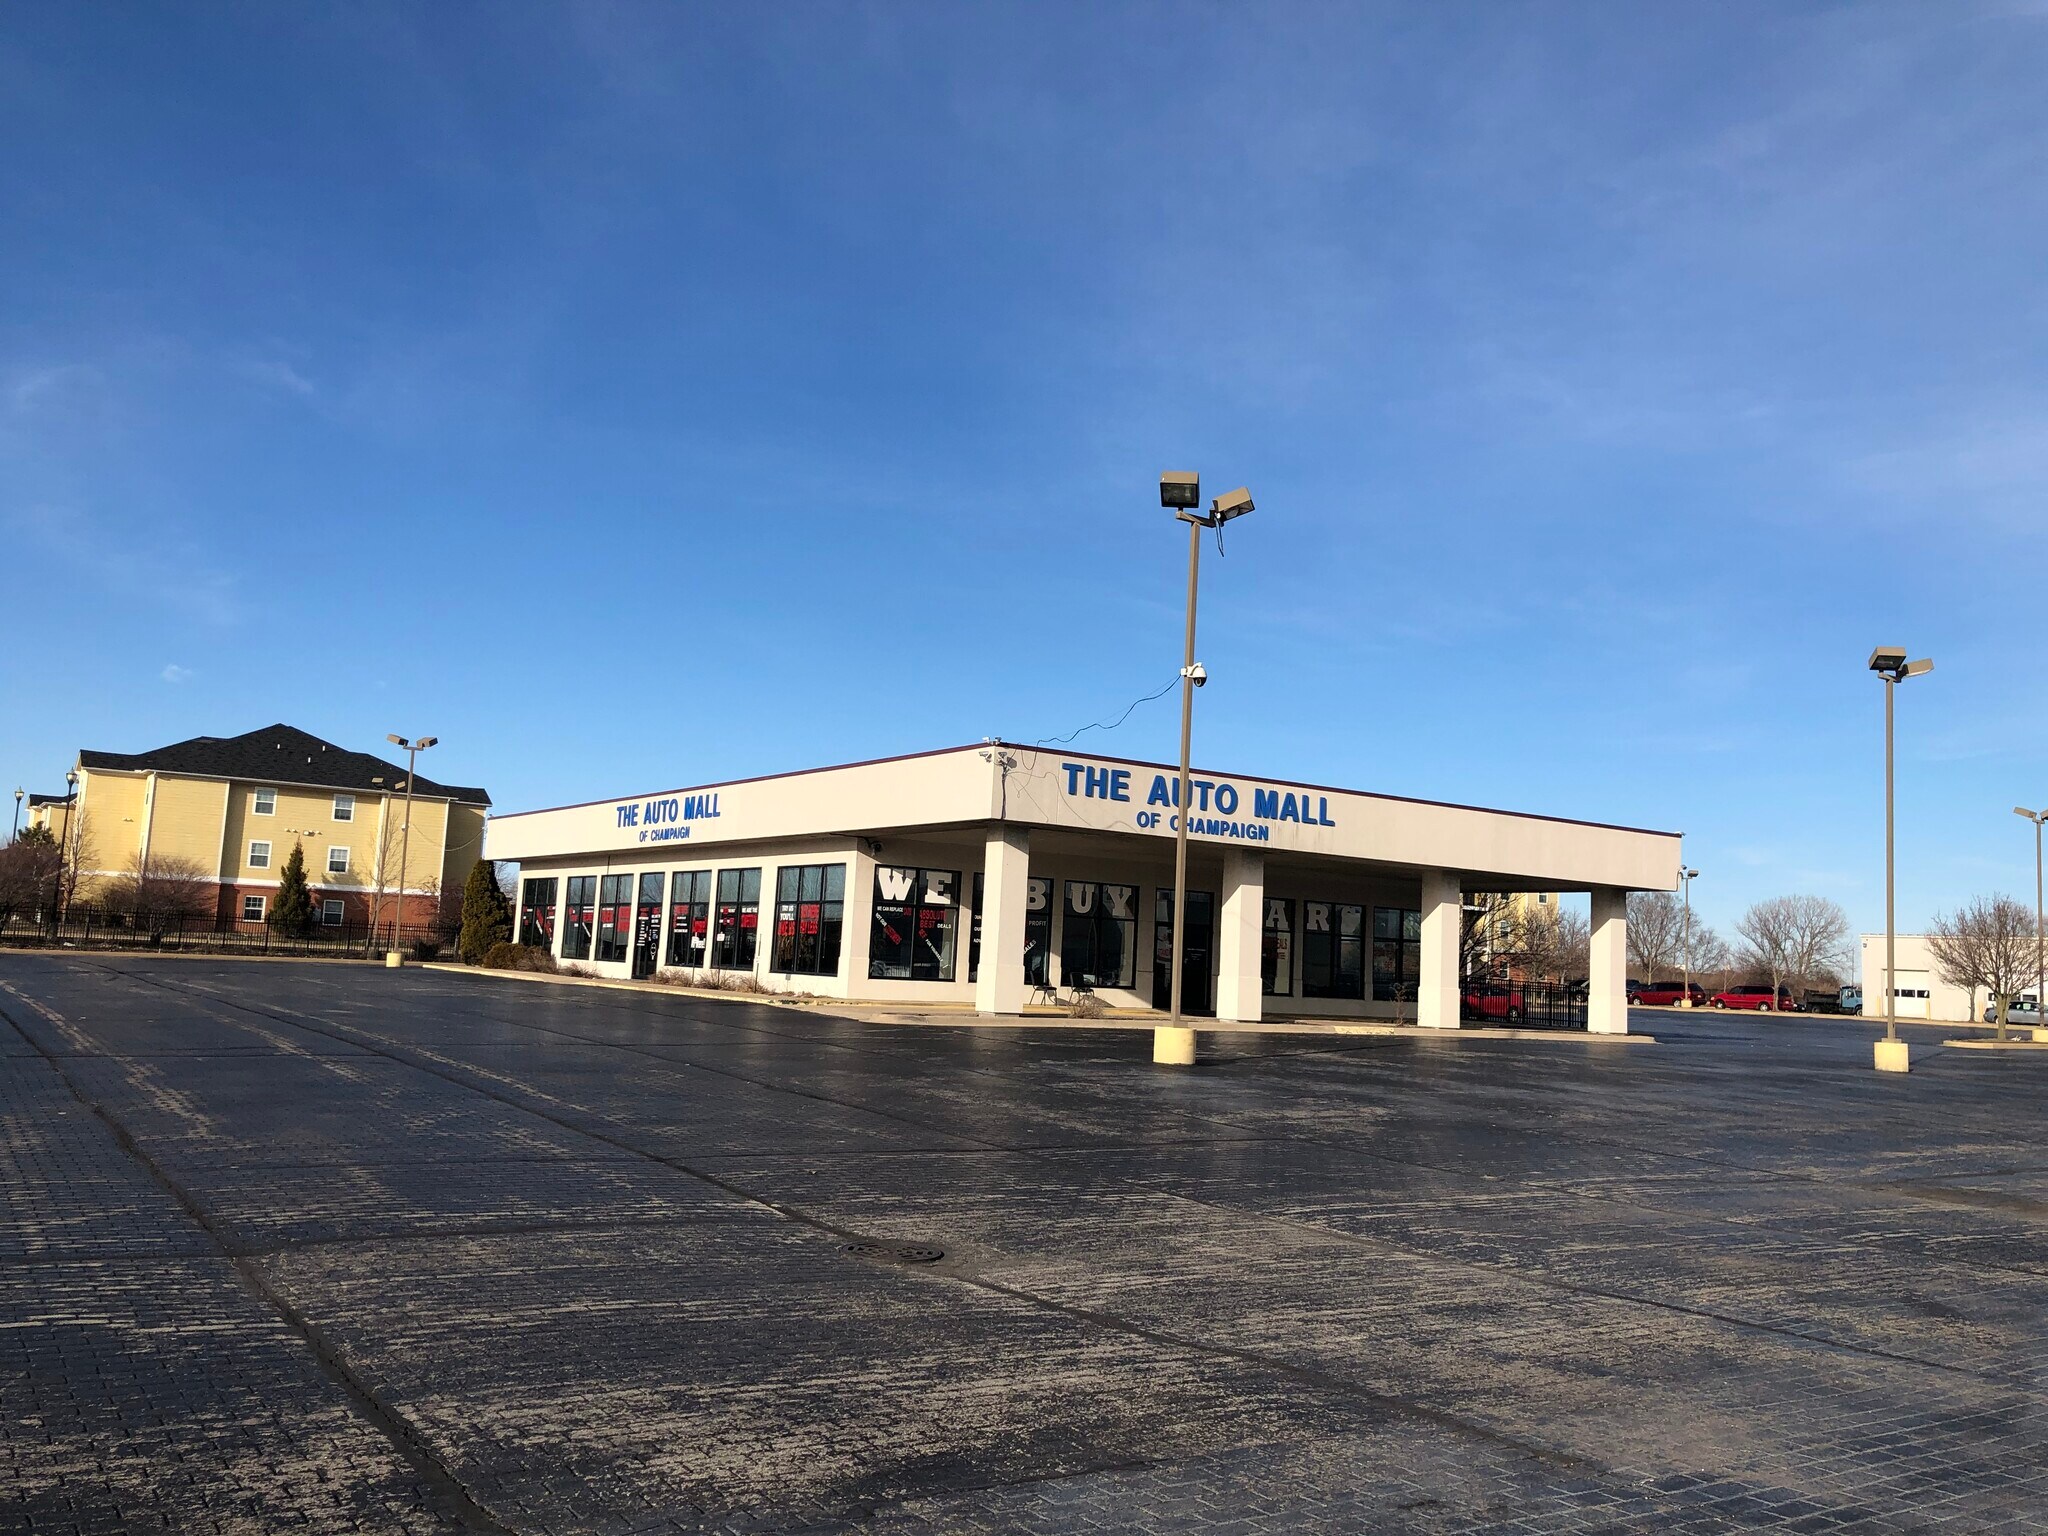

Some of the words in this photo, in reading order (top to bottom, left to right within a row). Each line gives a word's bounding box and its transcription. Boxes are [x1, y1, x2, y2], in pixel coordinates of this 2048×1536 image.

[616, 804, 639, 828] THE
[643, 799, 679, 825] AUTO
[684, 793, 721, 820] MALL
[1062, 763, 1131, 802] THE
[1147, 775, 1239, 815] AUTO
[1254, 788, 1336, 827] MALL
[639, 831, 648, 842] OF
[651, 826, 691, 841] CHAMPAIGN
[1136, 811, 1161, 828] OF
[1169, 815, 1269, 841] CHAMPAIGN
[878, 868, 952, 904] WE
[1026, 879, 1132, 917] BUY
[920, 909, 947, 920] ABSOLUT
